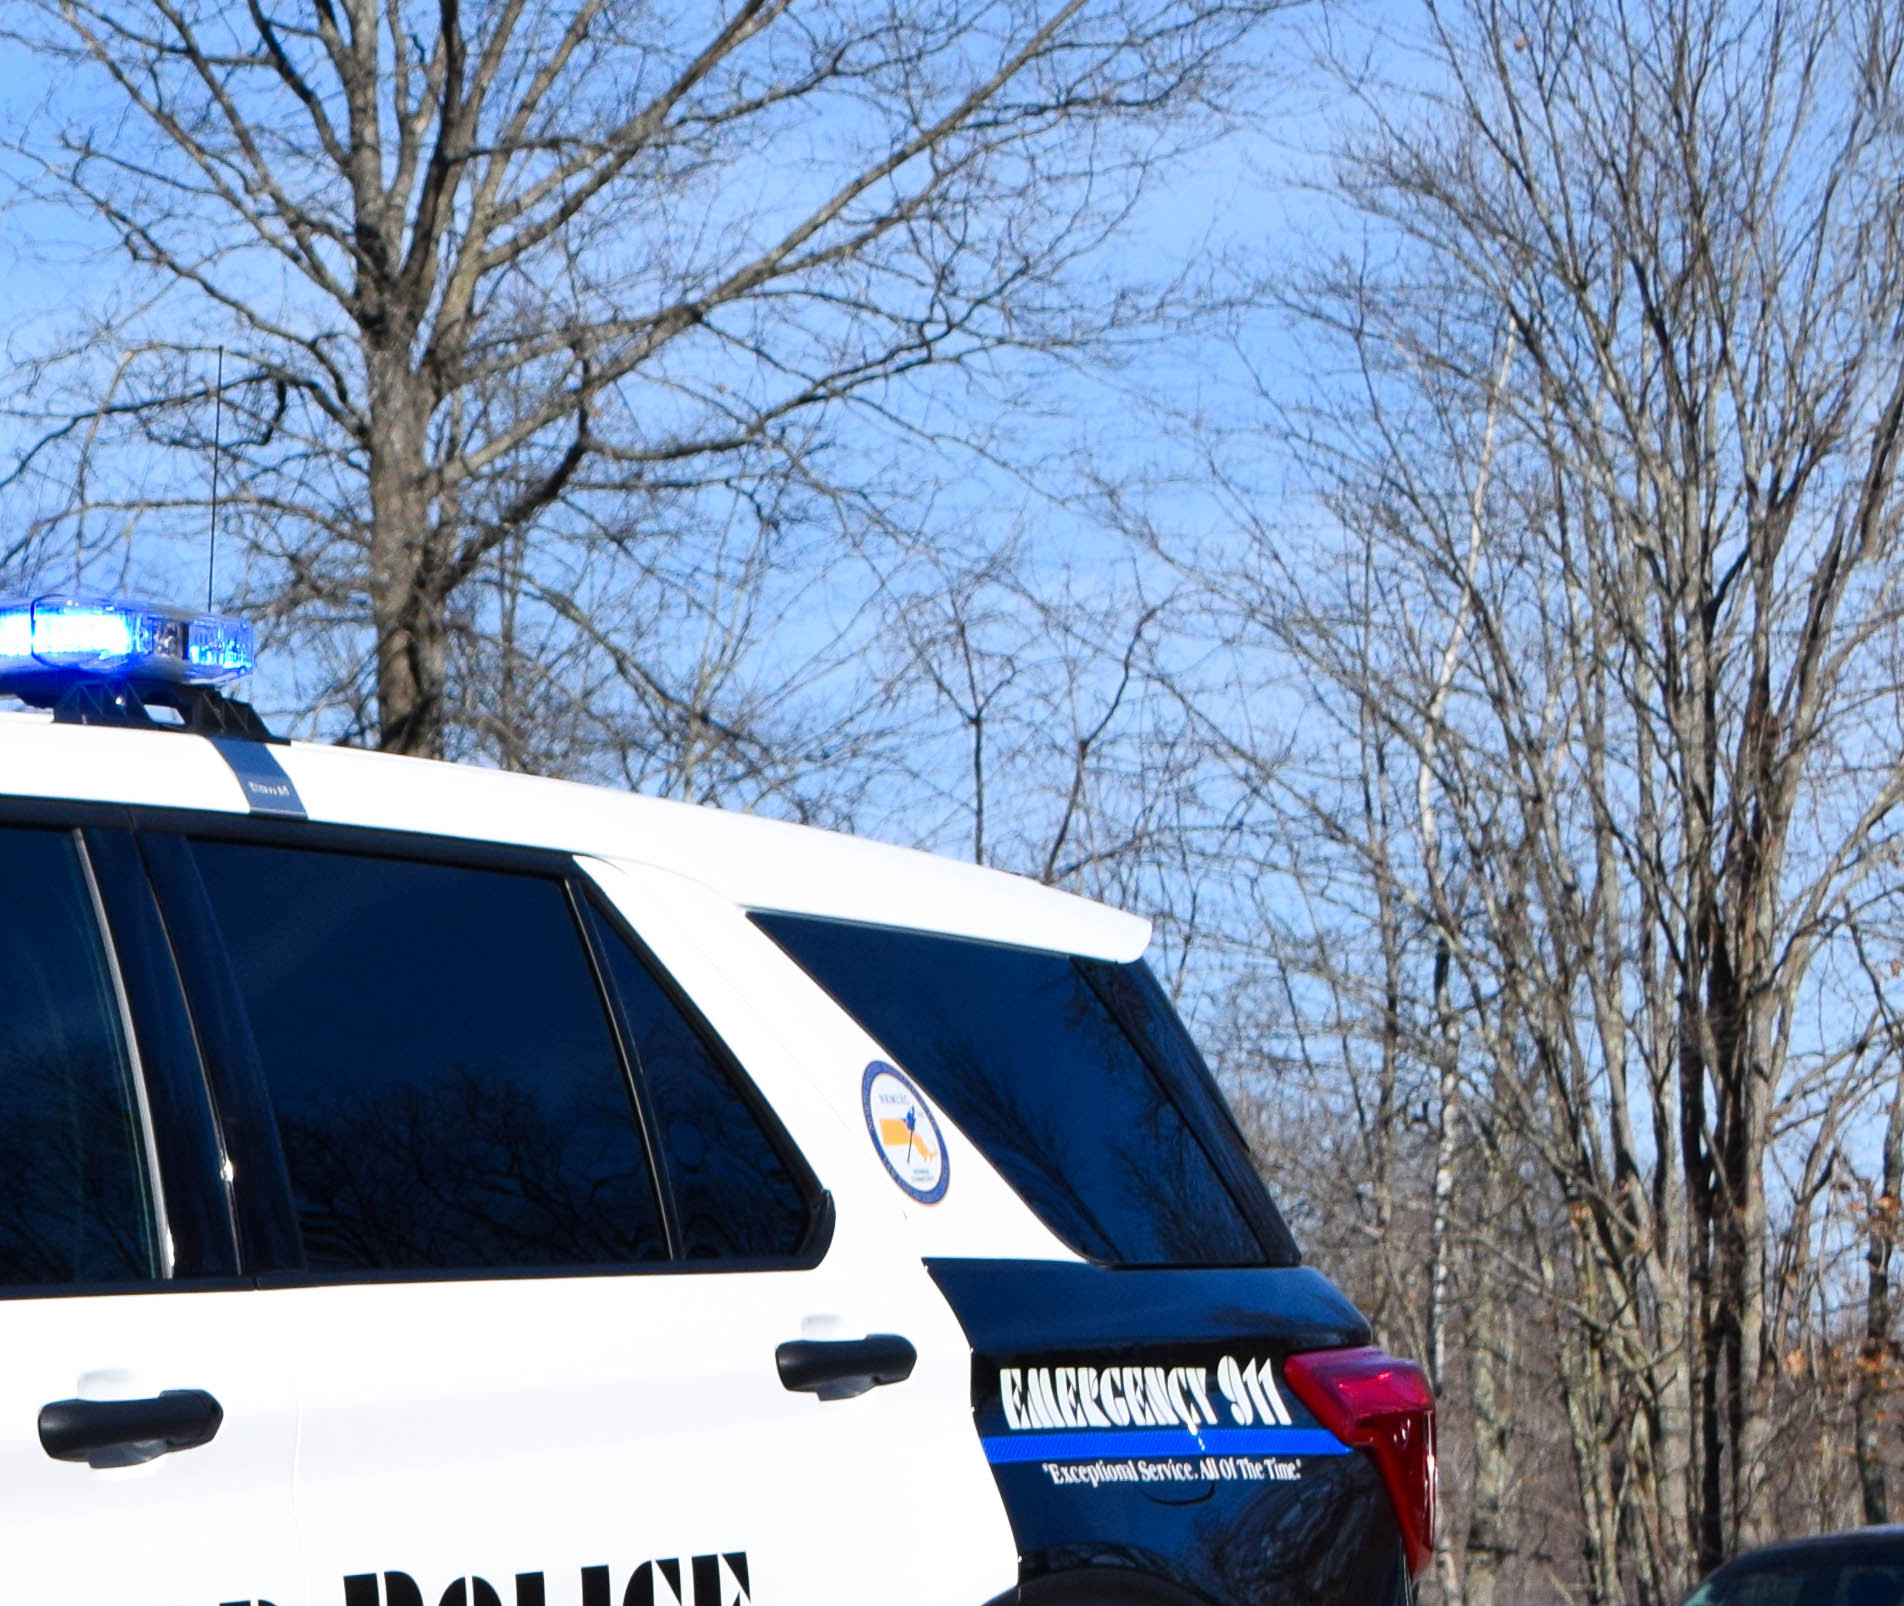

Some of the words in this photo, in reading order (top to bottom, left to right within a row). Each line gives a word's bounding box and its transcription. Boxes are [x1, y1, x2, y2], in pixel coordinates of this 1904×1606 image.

[1000, 1367, 1218, 1430] EMERGENCY
[1217, 1355, 1292, 1426] 911
[1199, 1457, 1220, 1480] All
[1220, 1457, 1237, 1480] Of
[1237, 1458, 1265, 1481] The
